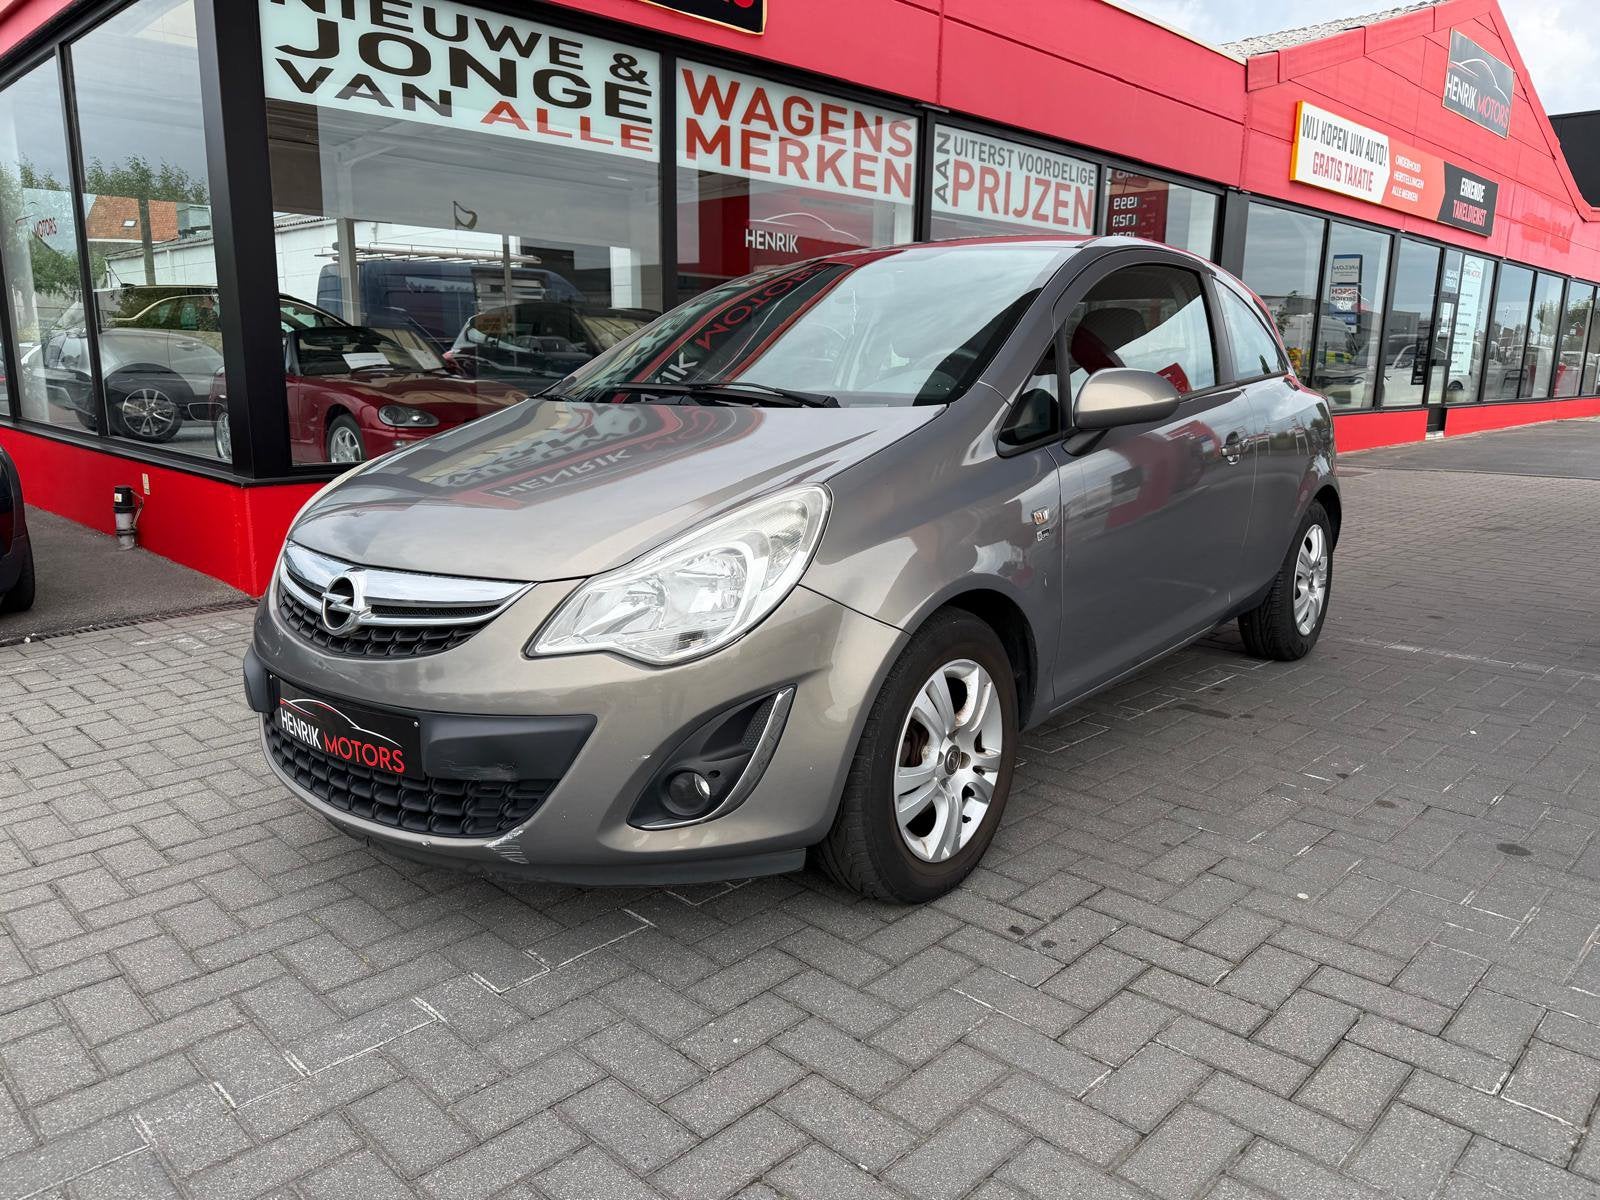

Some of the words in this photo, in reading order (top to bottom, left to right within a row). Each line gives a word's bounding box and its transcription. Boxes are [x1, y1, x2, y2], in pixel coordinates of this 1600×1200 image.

[270, 0, 583, 71] IEUWE
[608, 52, 650, 86] &
[275, 18, 653, 124] JONGE
[275, 57, 453, 118] VAN
[480, 100, 653, 152] ALLE
[681, 68, 913, 158] WAGENS
[1445, 72, 1478, 112] HENRIK
[1476, 92, 1511, 129] MOTORS
[685, 117, 912, 198] MERKEN
[934, 132, 950, 205] AAN
[953, 135, 1015, 169] UITERST
[1018, 151, 1095, 187] VOORDELIGE
[1302, 113, 1318, 141] WIJ
[1320, 120, 1347, 152] KOPEN
[1349, 132, 1365, 158] UW
[1364, 141, 1388, 168] AUTO!
[1312, 152, 1342, 184] GRATIS
[1343, 159, 1374, 192] TAXATIE
[951, 159, 1094, 230] PRIJZEN
[744, 228, 799, 254] HENRIK
[279, 708, 322, 750] HENRIK
[323, 731, 406, 774] MOTORS
